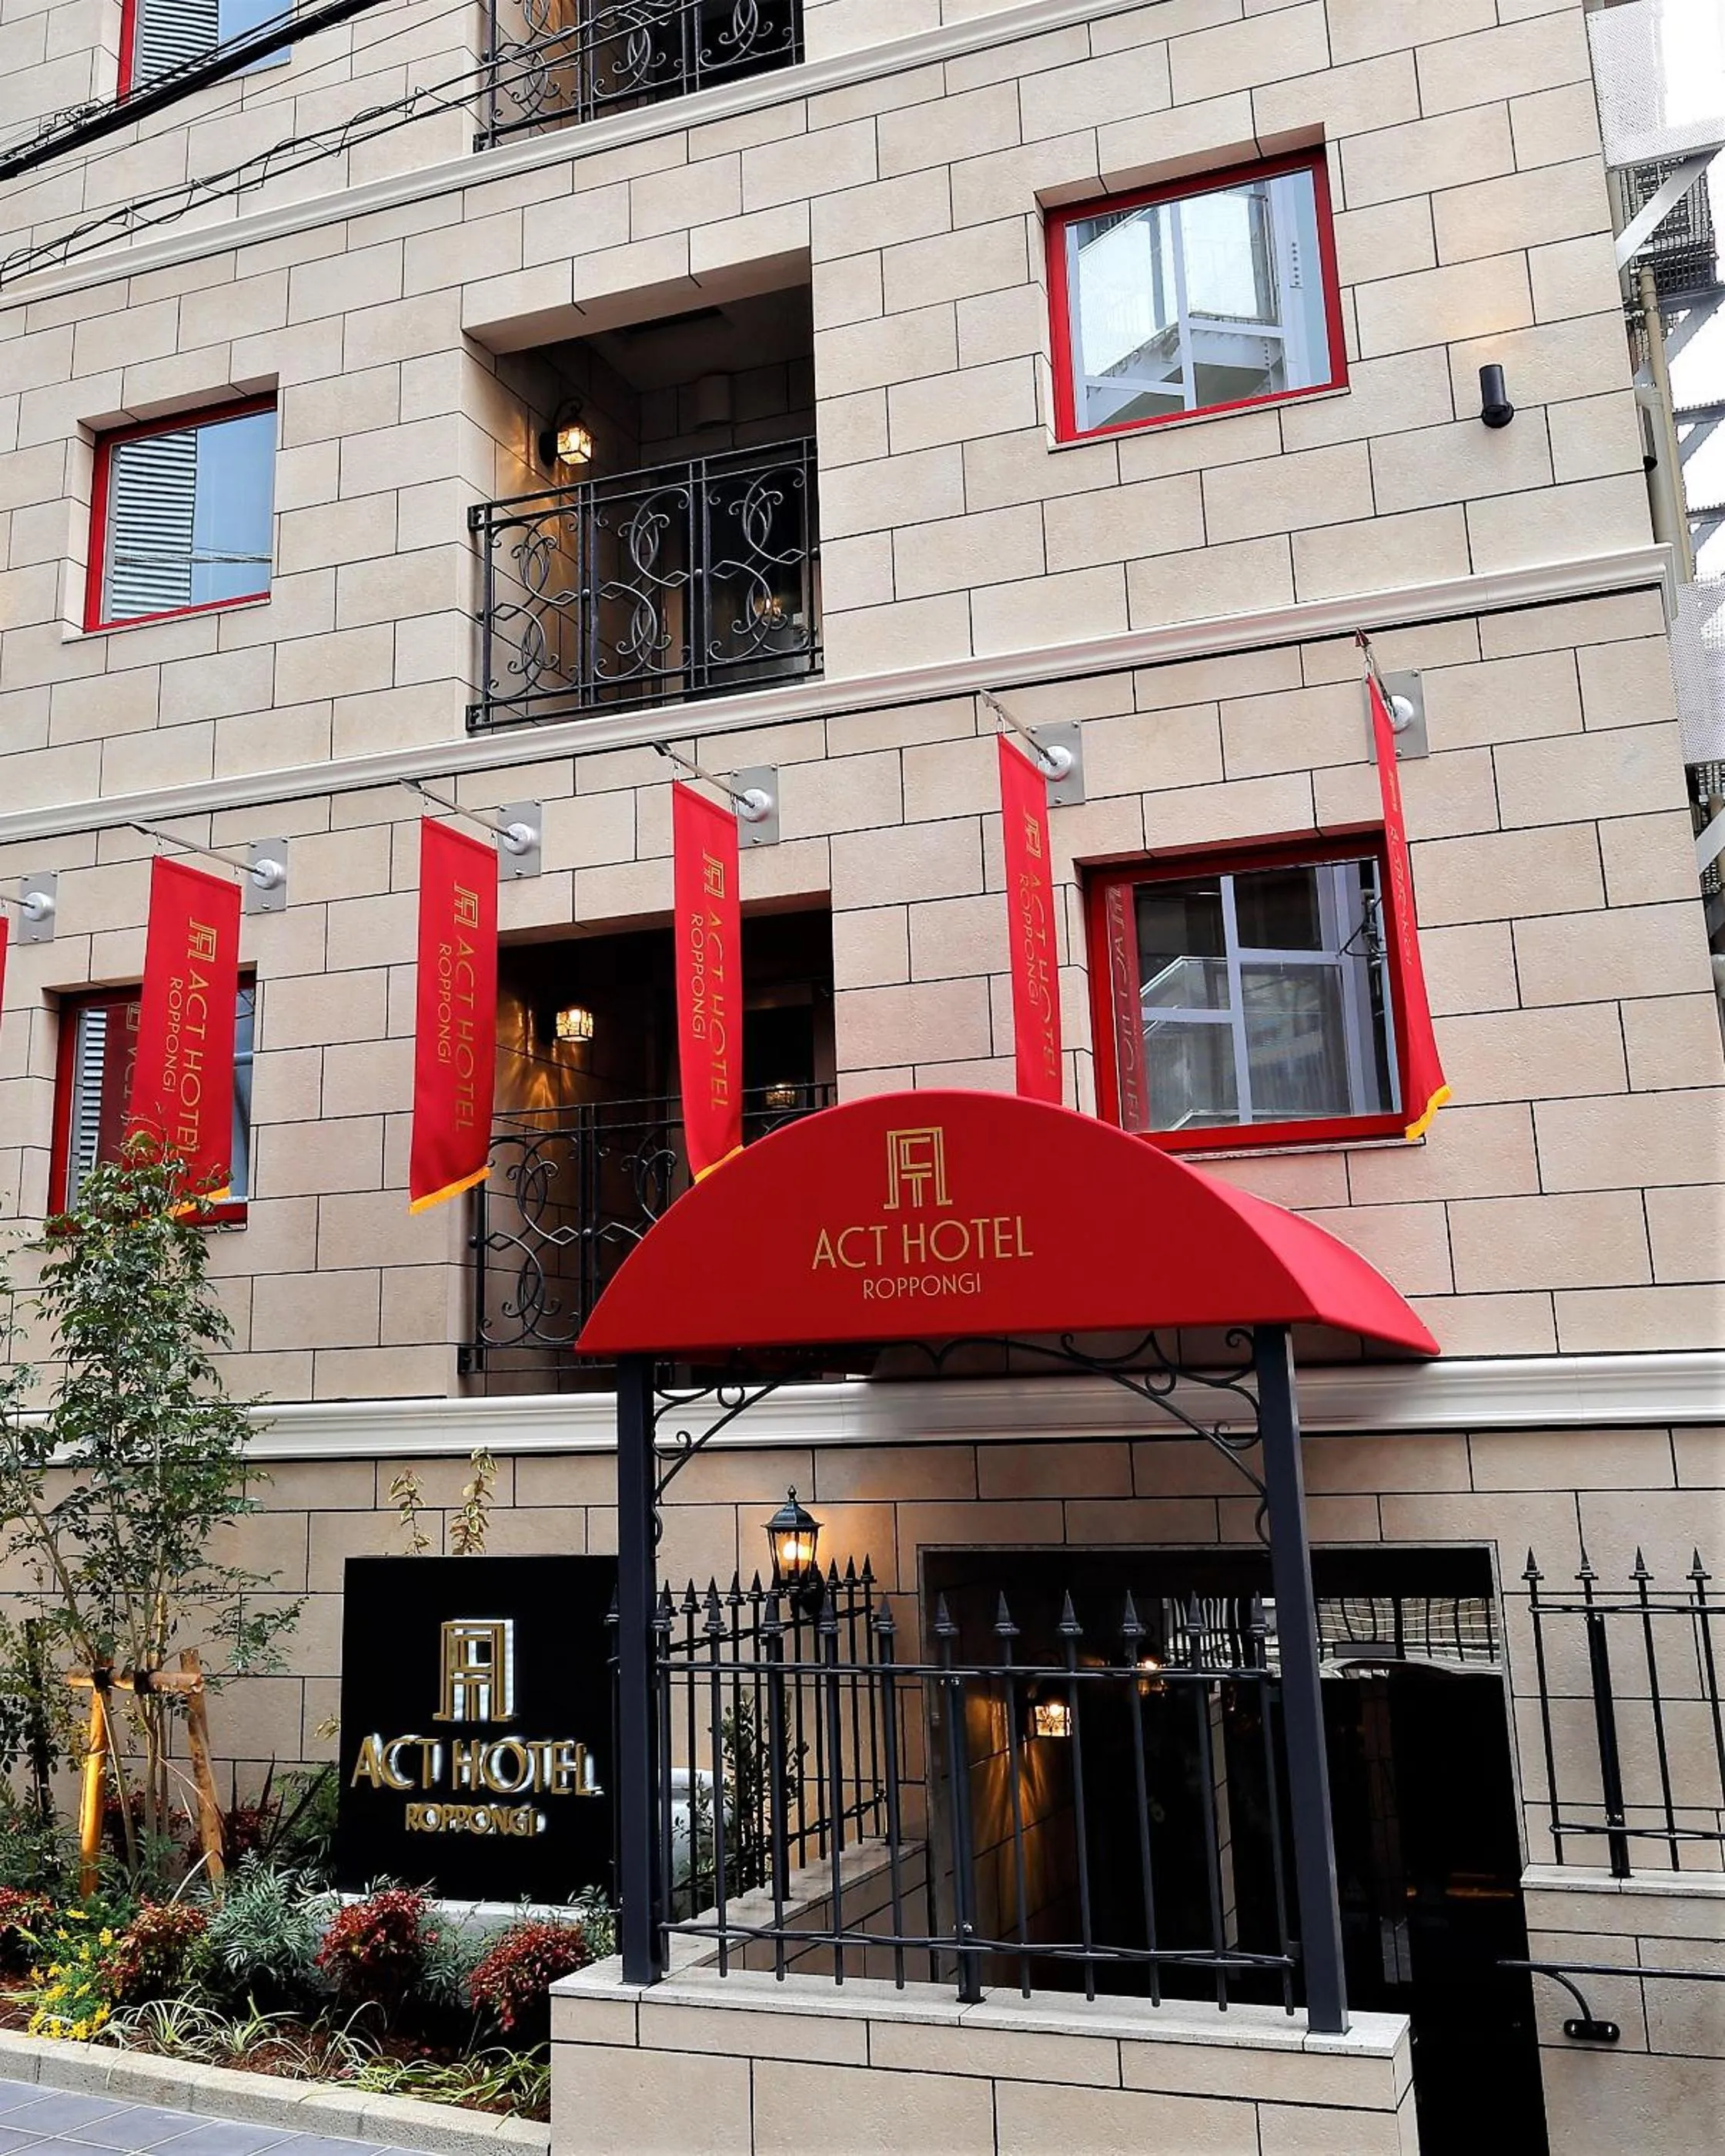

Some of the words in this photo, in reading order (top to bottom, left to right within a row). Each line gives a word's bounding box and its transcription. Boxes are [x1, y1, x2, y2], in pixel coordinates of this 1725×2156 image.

[707, 906, 724, 983] ACT
[1018, 872, 1039, 1006] ROPPONGI
[1031, 873, 1047, 948] ACT
[185, 968, 209, 1040] ACT
[437, 942, 453, 1065] ROPPONGI
[454, 934, 474, 1009] ACT
[690, 912, 706, 1041] ROPPONGI
[1038, 958, 1057, 1078] HOTEL
[162, 976, 184, 1094] ROPPONGI
[454, 1018, 474, 1133] HOTEL
[709, 994, 728, 1112] HOTEL
[176, 1048, 204, 1158] HOTEL
[811, 1225, 888, 1270] ACT
[902, 1215, 1034, 1265] HOTEL
[862, 1272, 981, 1300] ROPPONGI
[350, 1735, 443, 1790] ACT
[452, 1736, 605, 1797] HOTEL
[404, 1803, 546, 1837] ROPPONGI
